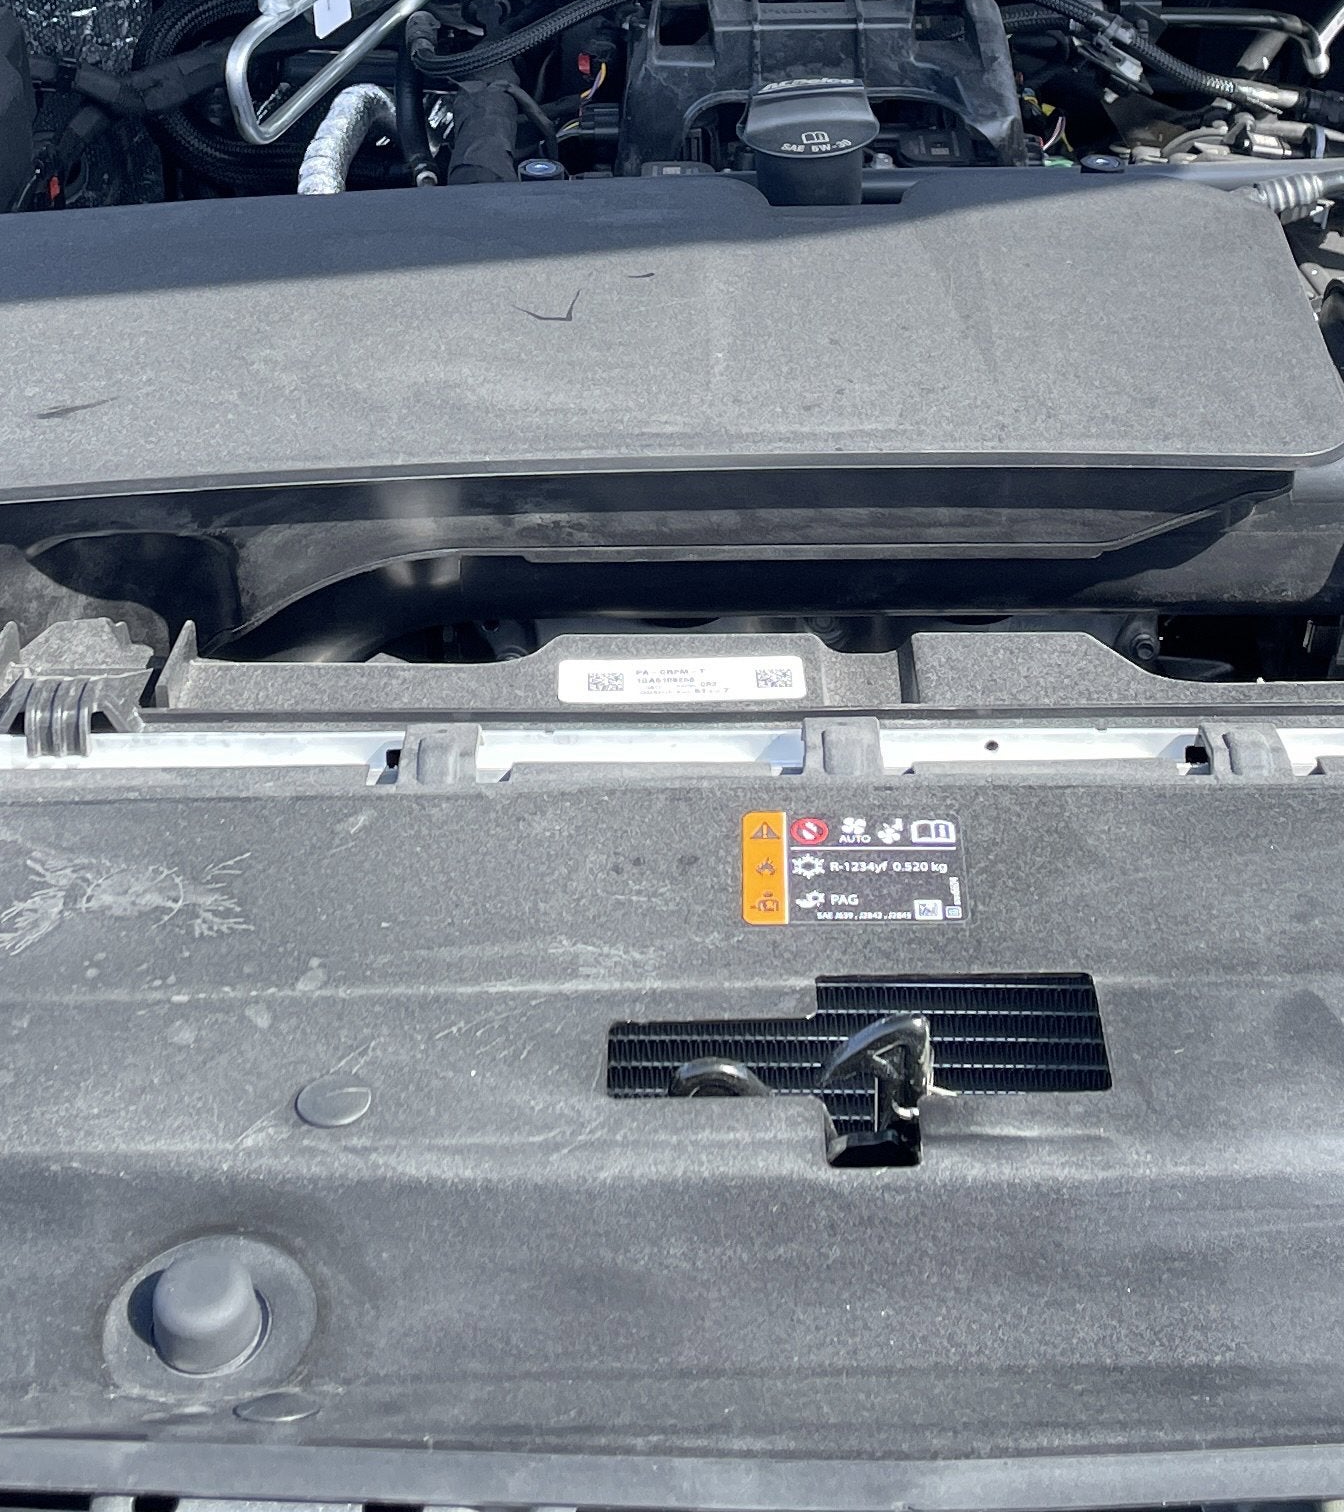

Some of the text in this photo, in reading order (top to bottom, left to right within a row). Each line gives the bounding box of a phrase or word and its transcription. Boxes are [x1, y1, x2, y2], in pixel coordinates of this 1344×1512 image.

[780, 139, 852, 152] SAE 5W-30
[839, 834, 871, 843] AUTO
[830, 862, 947, 874] R-1234yf 0.520 kg
[831, 894, 858, 905] PAG
